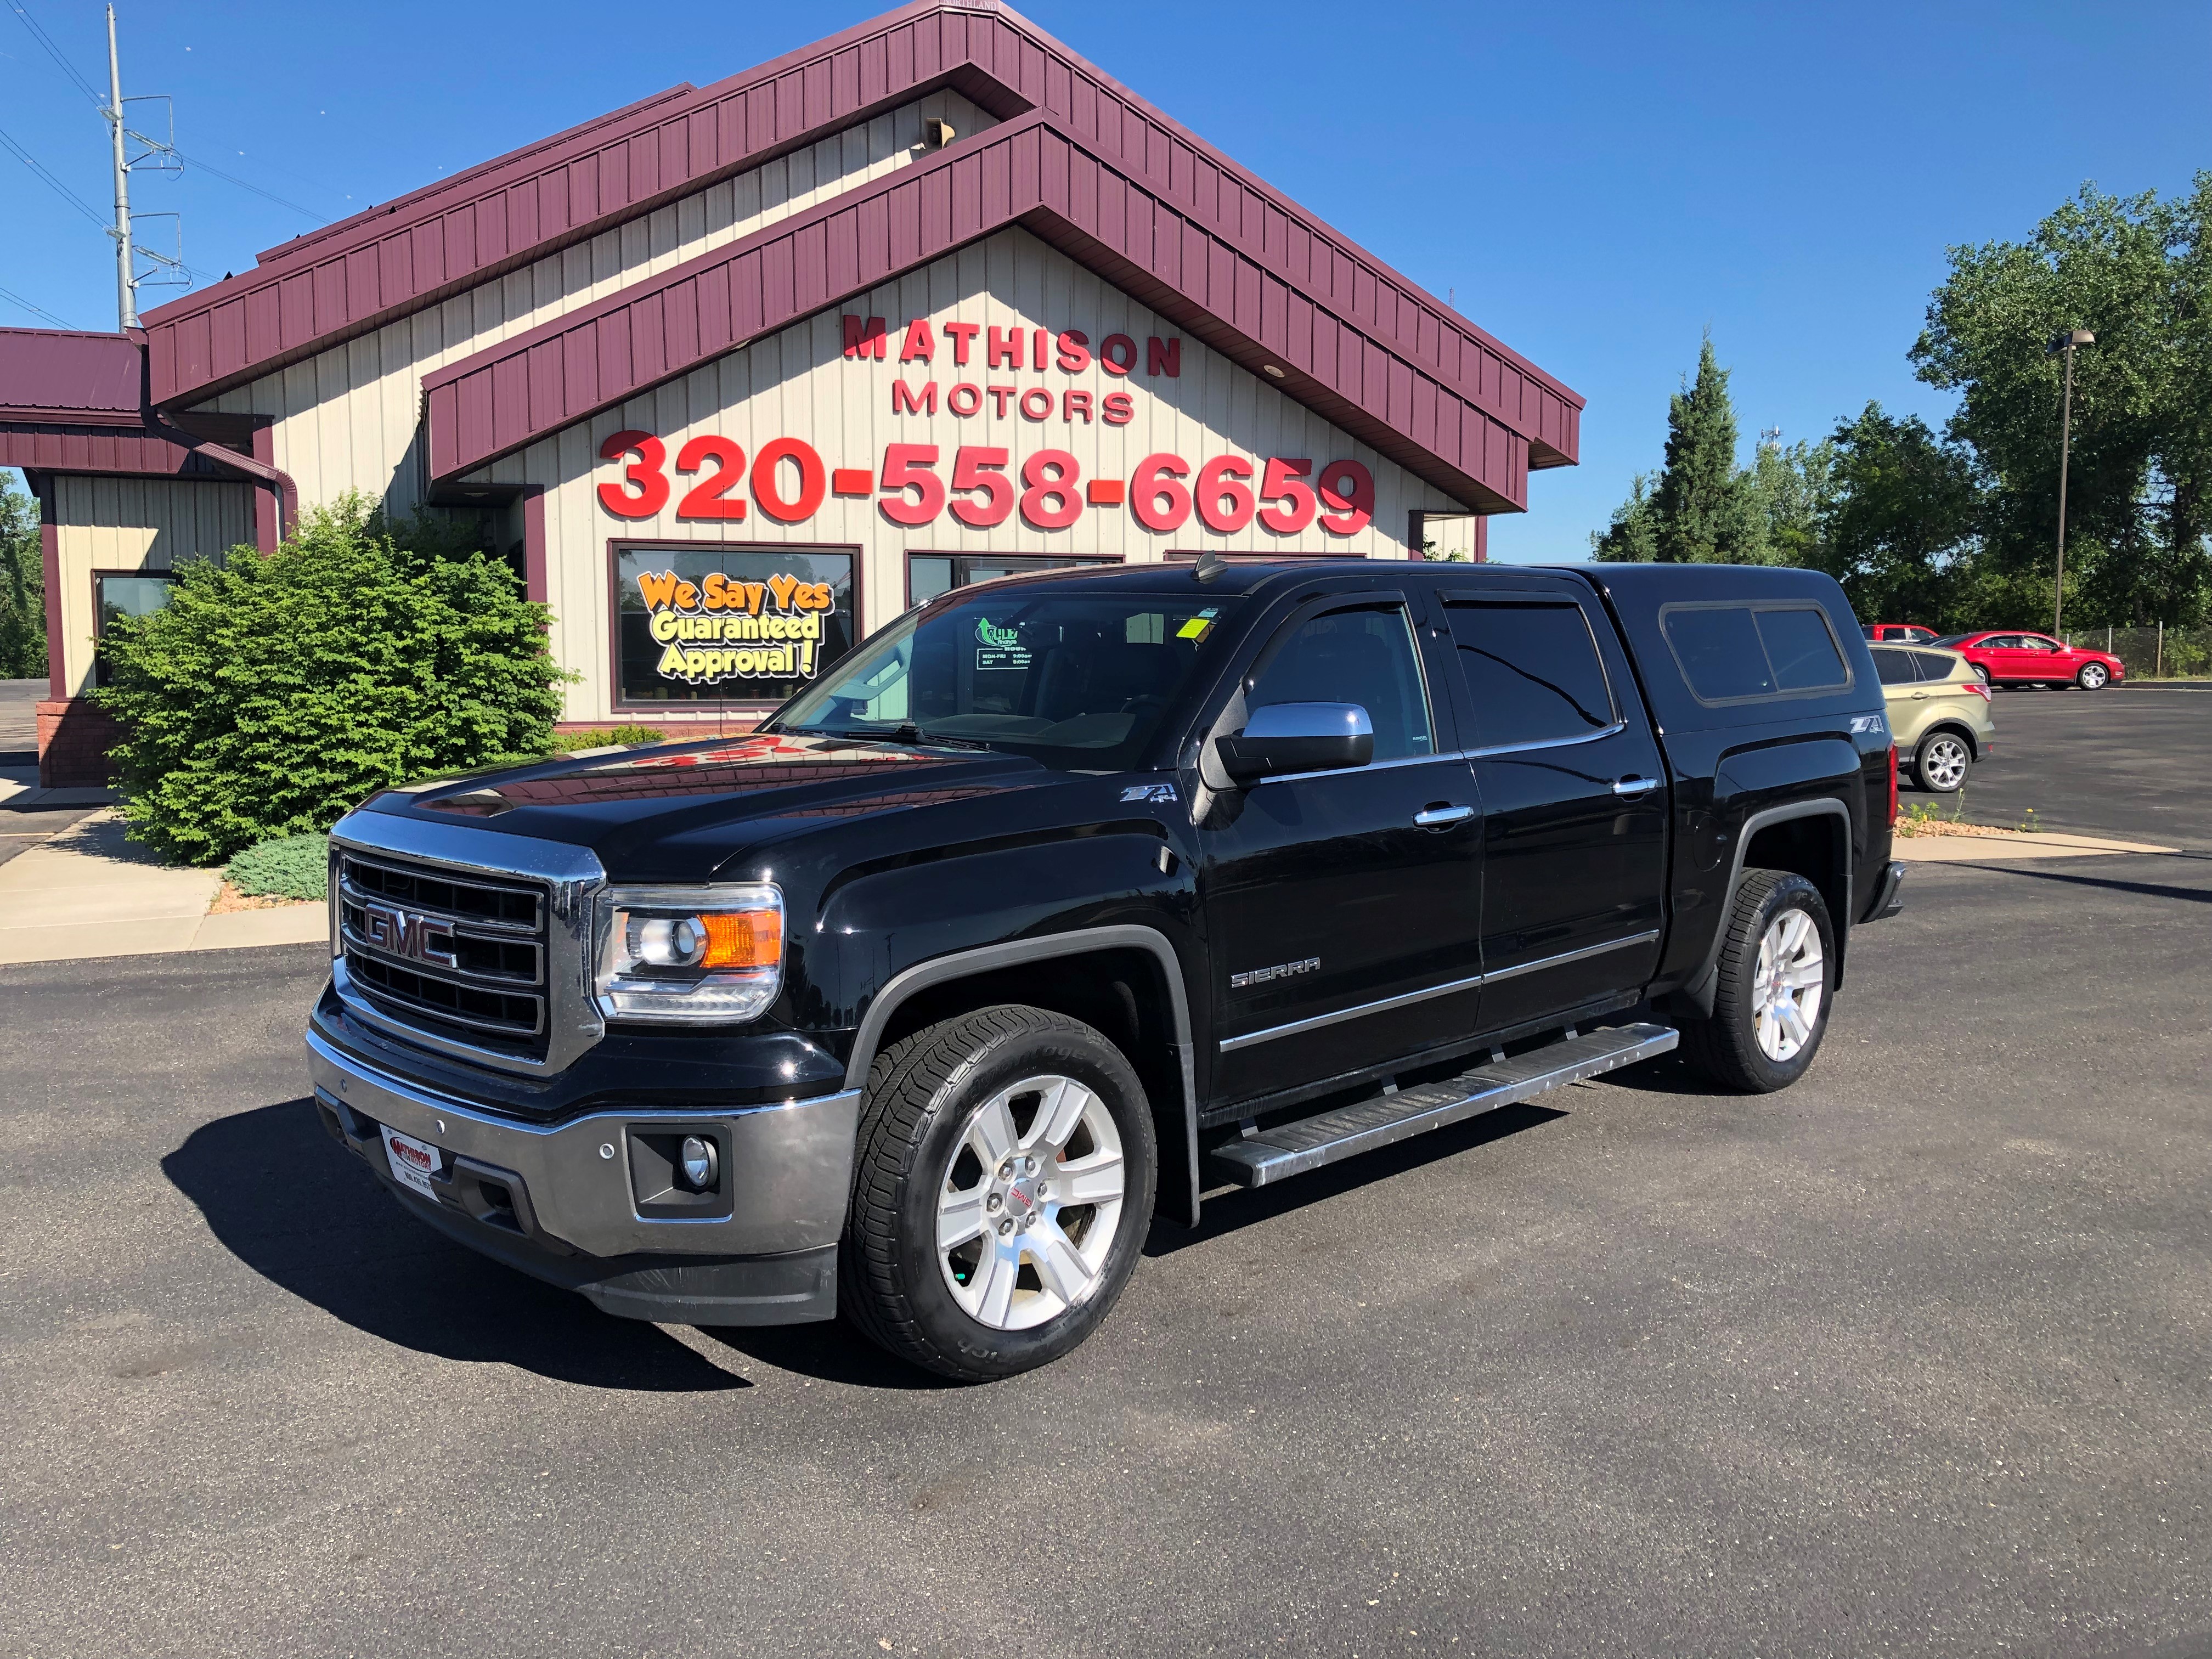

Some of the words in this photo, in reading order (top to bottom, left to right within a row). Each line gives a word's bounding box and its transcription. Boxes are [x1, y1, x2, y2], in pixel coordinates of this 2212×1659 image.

[843, 314, 1181, 377] MATHISON
[893, 379, 1136, 424] MOTORS
[597, 430, 1376, 535] 320-558-6659
[638, 571, 698, 610] We
[704, 573, 766, 615] Say
[769, 574, 832, 610] Yes
[652, 610, 821, 641] Guaranteed
[364, 903, 459, 968] GMC
[1231, 957, 1321, 989] SIERRA
[1011, 1187, 1032, 1207] GMC
